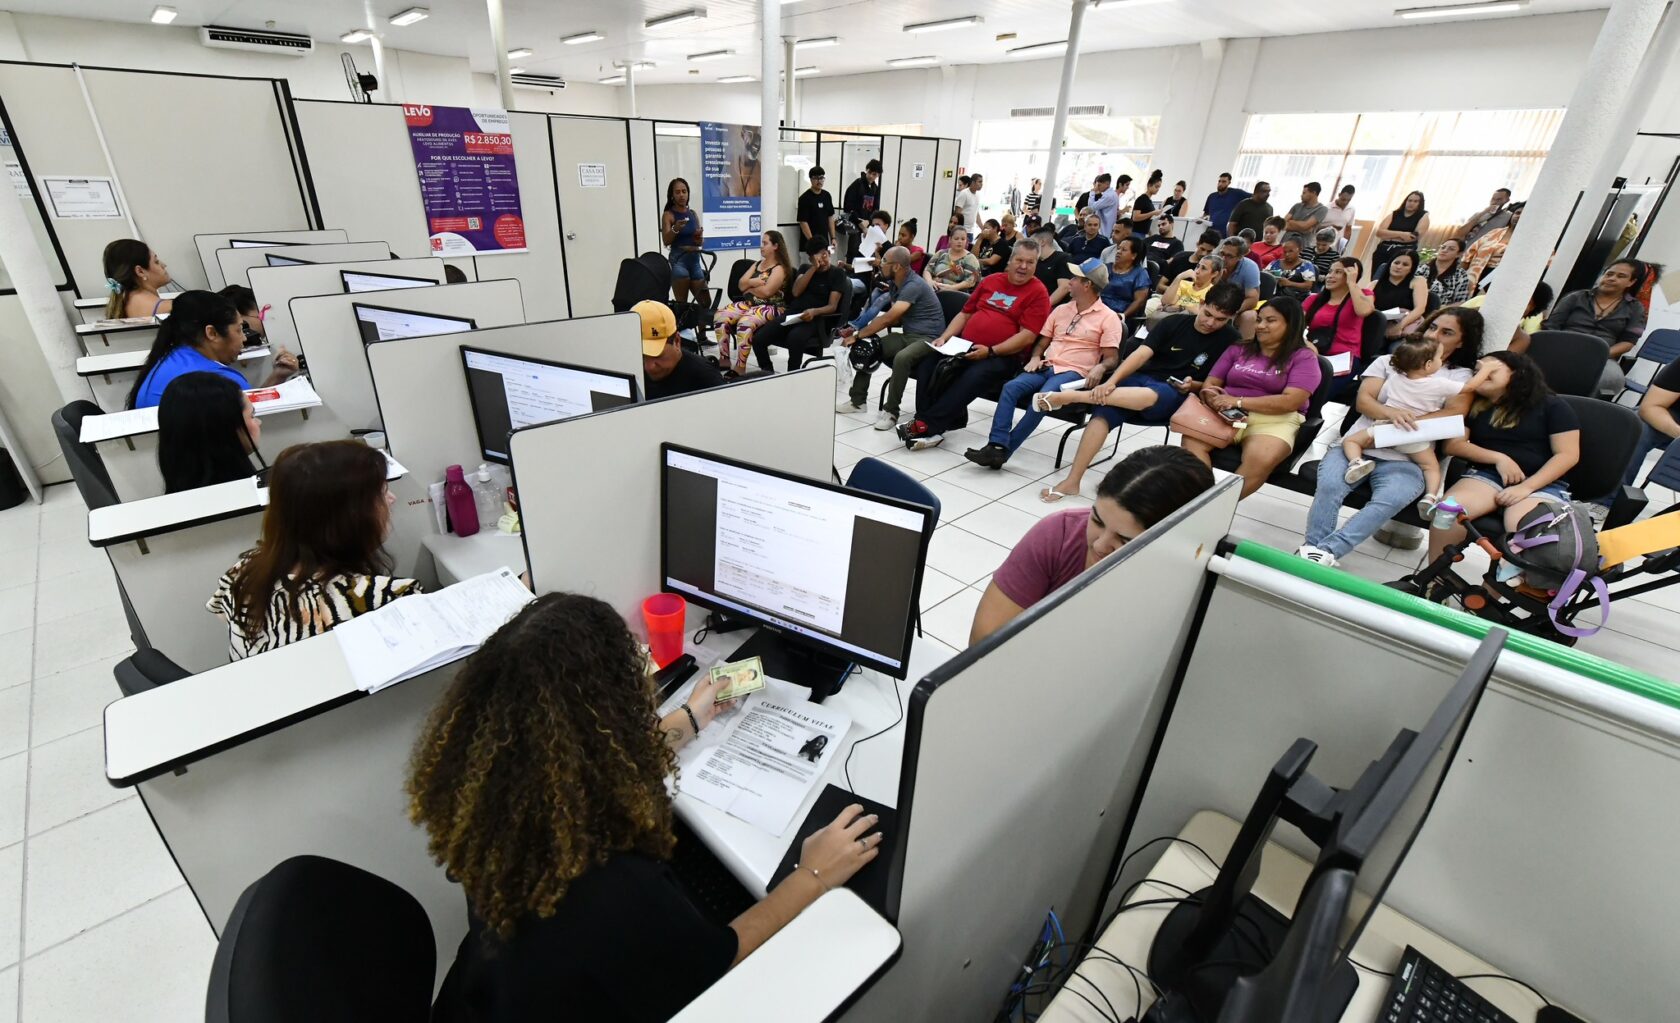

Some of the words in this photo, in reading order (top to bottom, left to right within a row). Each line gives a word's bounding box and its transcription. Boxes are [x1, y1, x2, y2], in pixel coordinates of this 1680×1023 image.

[404, 105, 431, 117] LEVO
[464, 135, 476, 145] R$
[477, 135, 512, 146] 2.850,30
[651, 327, 659, 337] LA
[760, 701, 810, 722] CURRICULUM
[811, 719, 834, 730] VITAE
